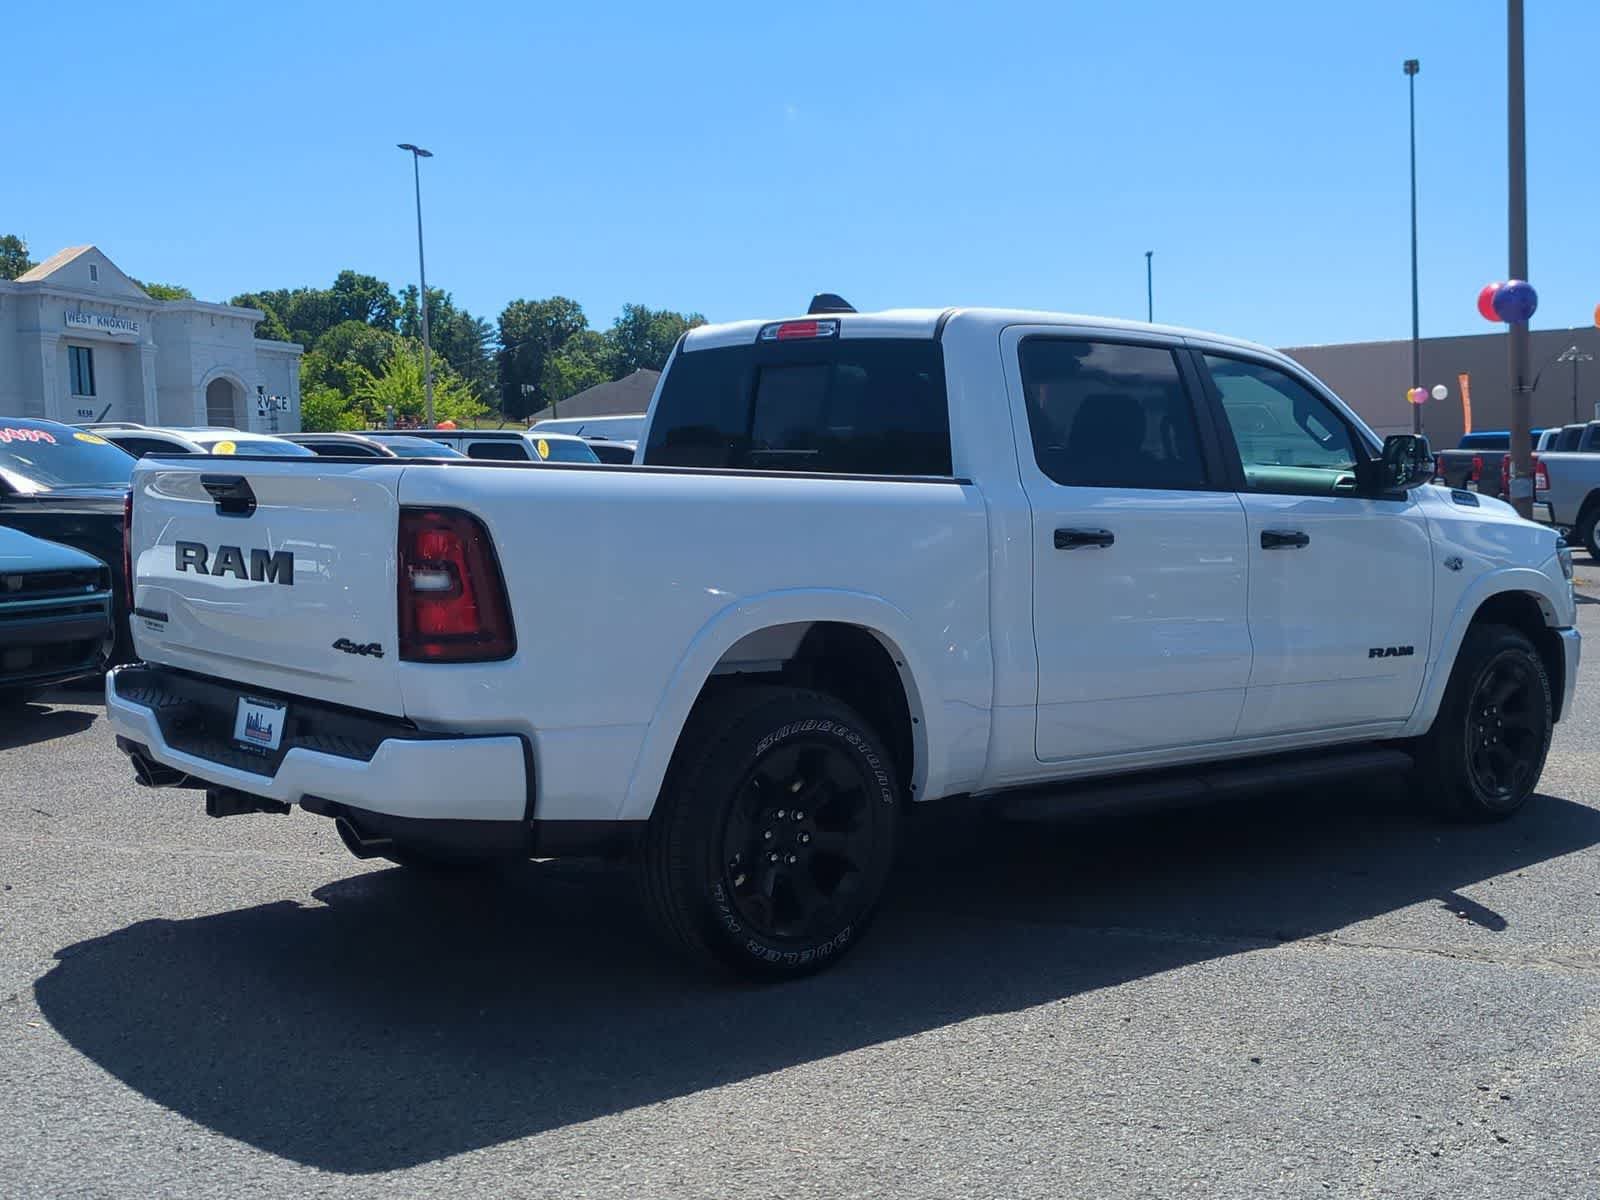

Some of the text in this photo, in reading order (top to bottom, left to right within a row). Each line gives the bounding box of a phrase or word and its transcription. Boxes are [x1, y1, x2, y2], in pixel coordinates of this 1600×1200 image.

[67, 312, 91, 325] WEST
[257, 395, 287, 410] RVCE
[175, 540, 295, 586] RAM
[1368, 646, 1414, 658] RAM
